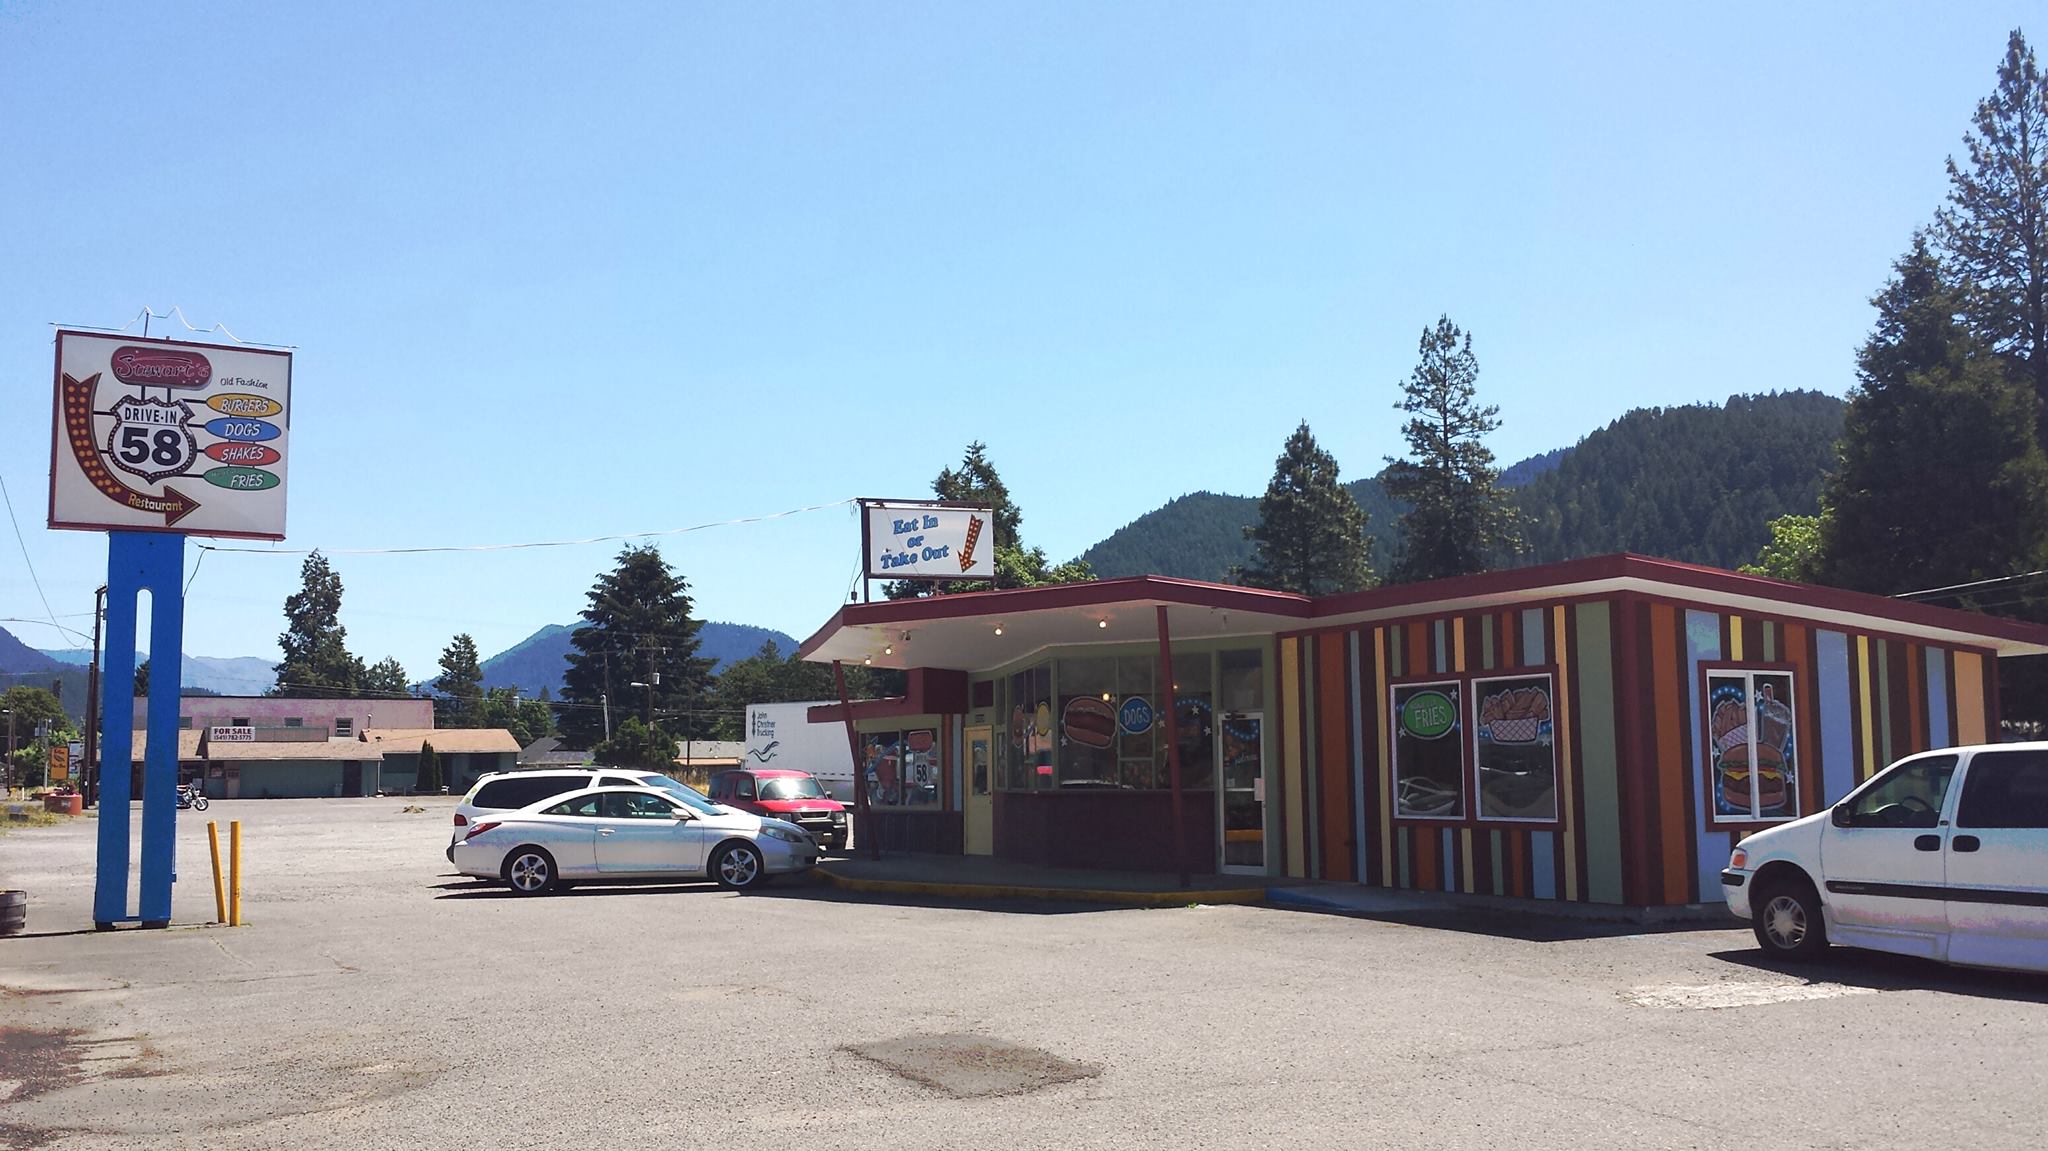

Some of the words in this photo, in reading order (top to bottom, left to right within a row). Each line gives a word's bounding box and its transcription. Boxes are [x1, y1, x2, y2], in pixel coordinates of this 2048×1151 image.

[116, 354, 210, 378] Stewart's
[220, 377, 234, 386] Old
[235, 377, 268, 390] Fashion
[221, 398, 269, 413] BURGERS
[124, 407, 177, 424] DRIVE-IN
[225, 423, 261, 437] DOGS
[120, 427, 182, 466] 58
[221, 446, 265, 461] SHAKES
[230, 474, 264, 488] FRIES
[128, 493, 183, 511] Restaurant
[893, 519, 918, 535] Eat
[922, 514, 939, 530] In
[907, 535, 924, 549] or
[880, 551, 918, 570] Take
[921, 544, 949, 562] Out
[1124, 706, 1150, 727] DOGS
[1414, 705, 1448, 729] FRIES
[916, 764, 928, 782] 58
